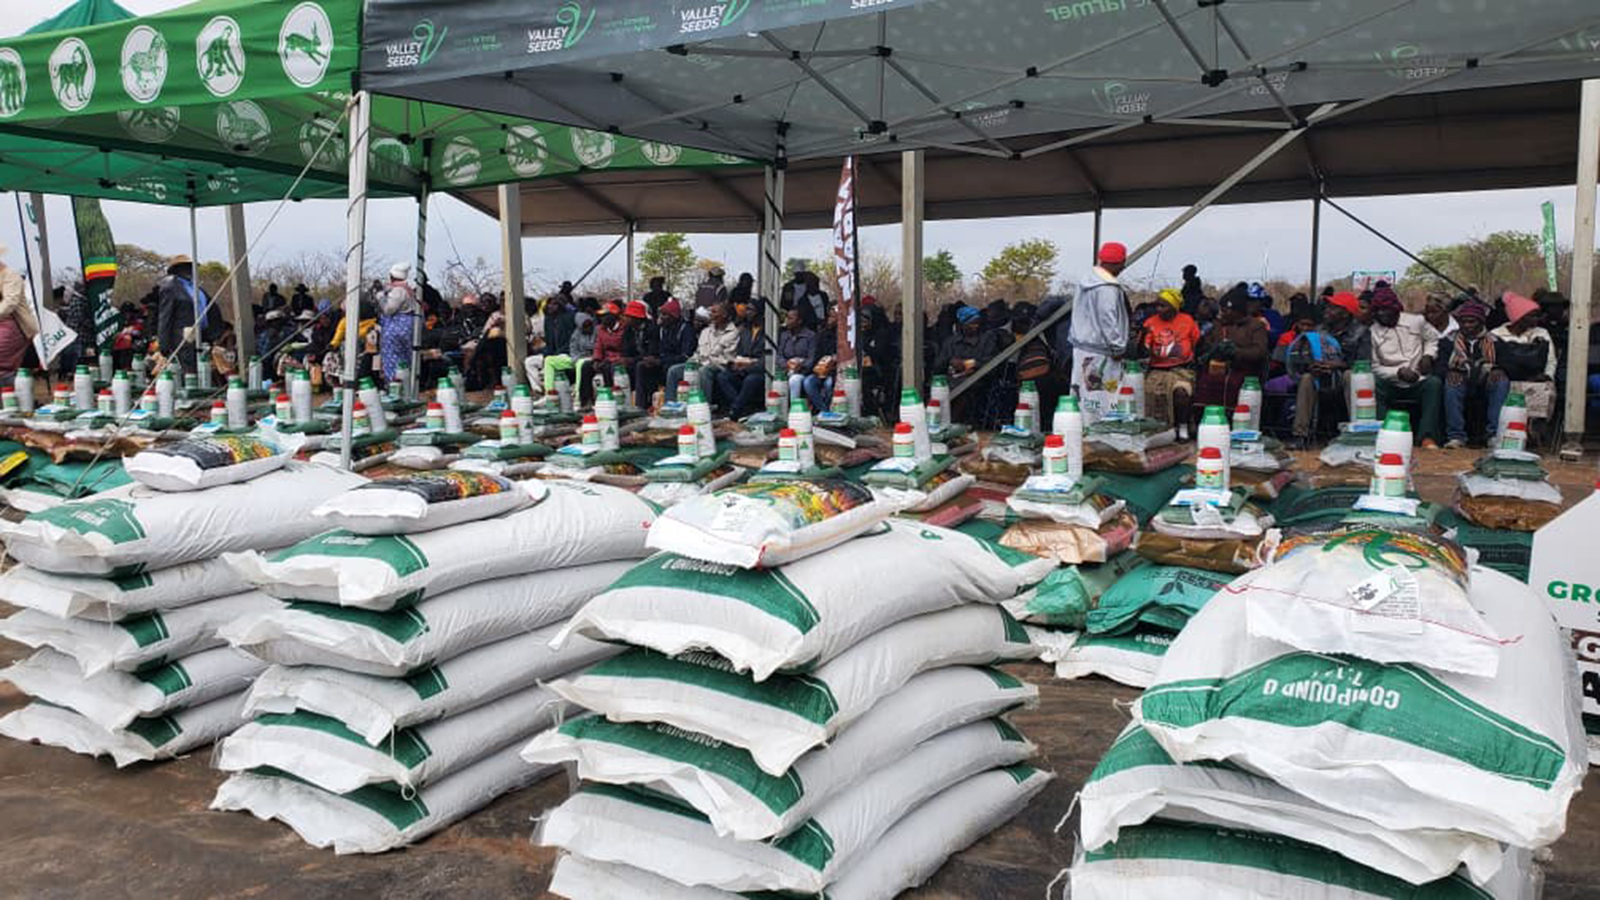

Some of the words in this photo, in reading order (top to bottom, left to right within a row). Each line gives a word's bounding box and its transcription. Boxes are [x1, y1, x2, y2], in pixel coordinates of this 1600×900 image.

[679, 4, 726, 21] VALLEY
[679, 17, 721, 33] SEEDS
[527, 26, 569, 41] VALLEY
[386, 41, 423, 56] VALLEY
[527, 39, 563, 53] SEEDS
[386, 54, 419, 67] SEEDS
[1547, 580, 1600, 604] GR
[1280, 680, 1400, 709] COMPOUND
